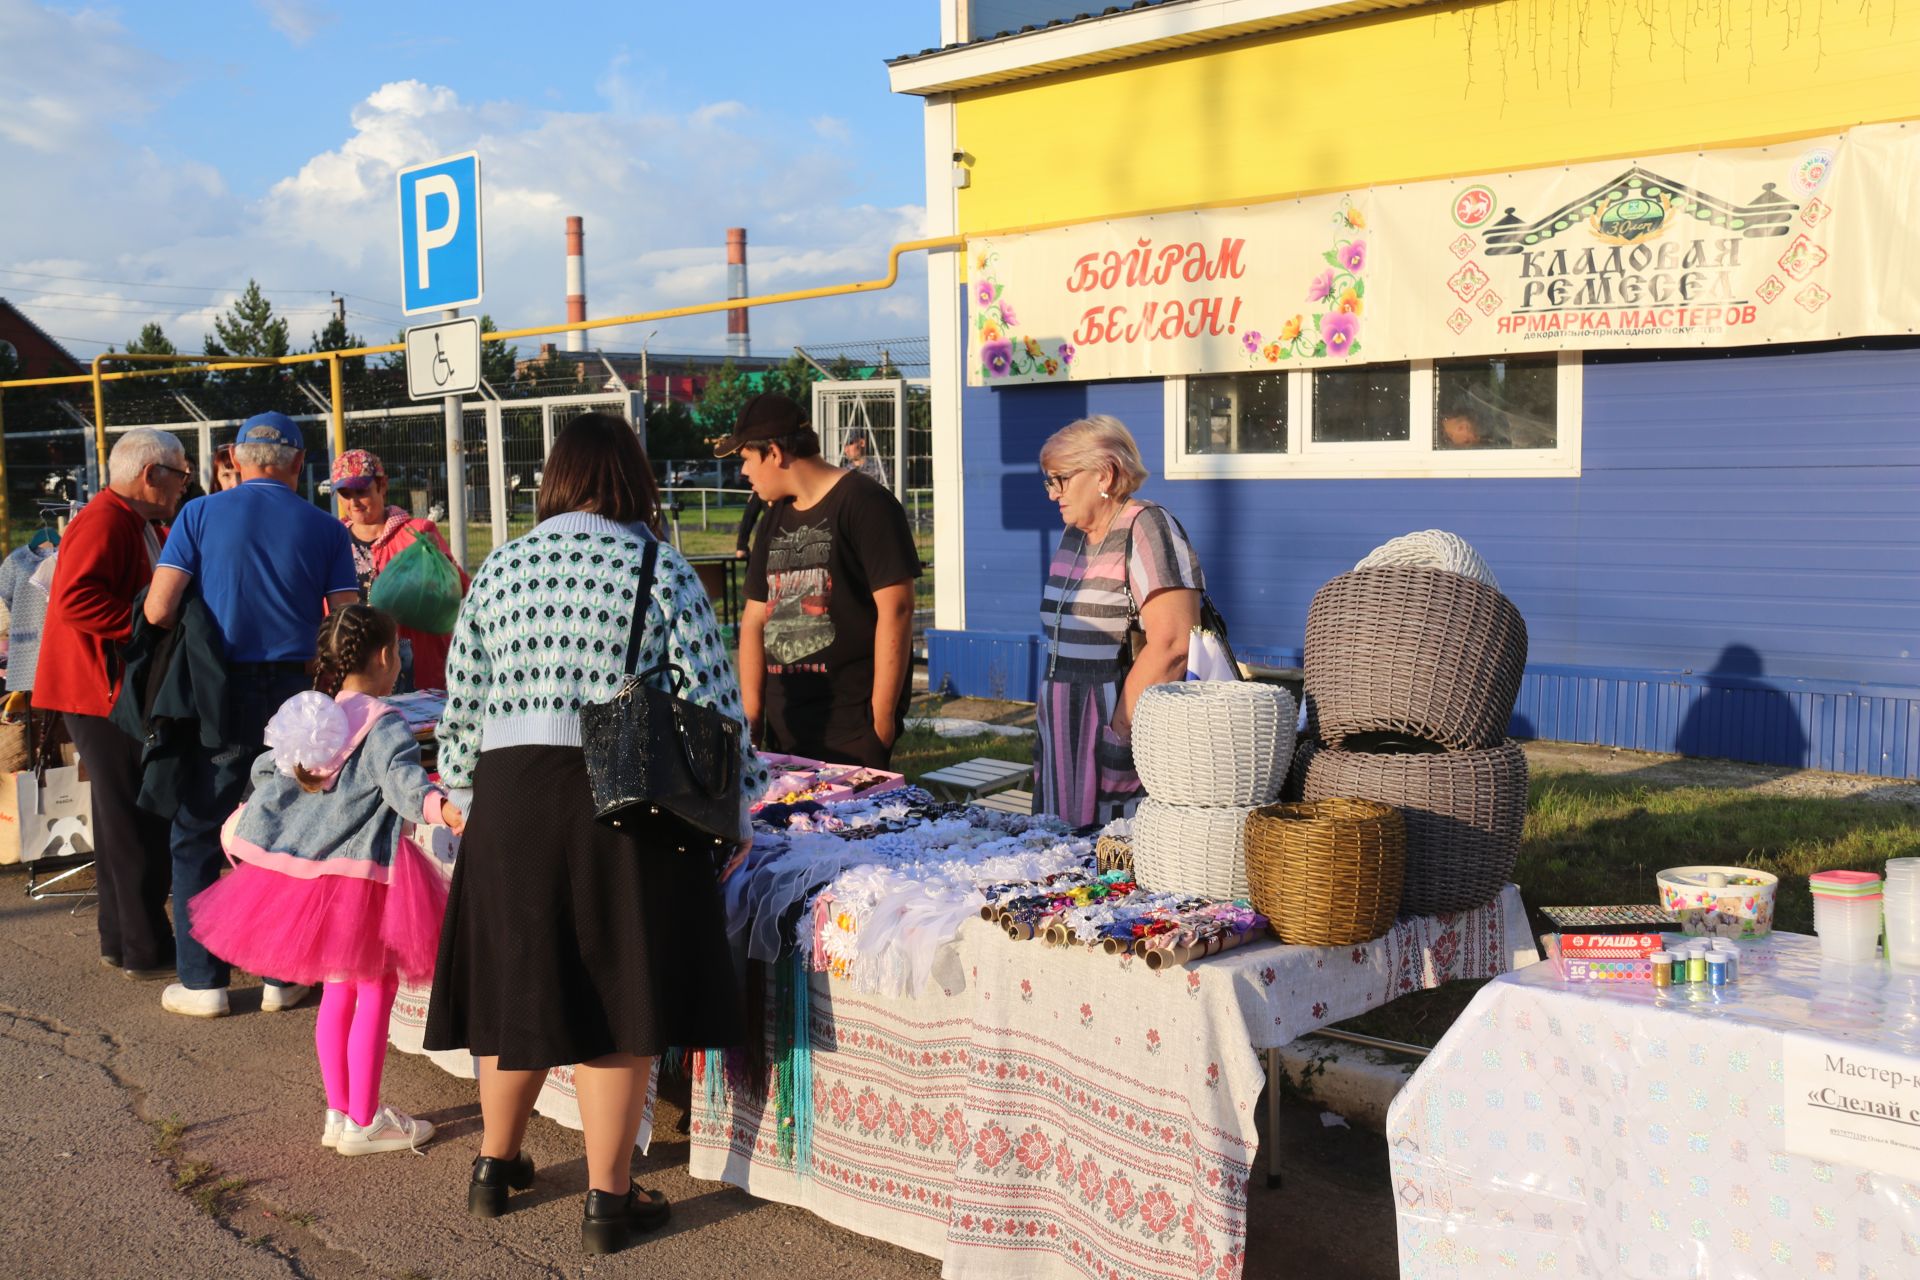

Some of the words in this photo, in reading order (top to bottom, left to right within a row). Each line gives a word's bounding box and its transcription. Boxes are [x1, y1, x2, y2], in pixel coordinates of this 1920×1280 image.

[415, 174, 461, 289] P
[1607, 220, 1631, 235] 30
[1519, 238, 1743, 278] КЛАДОВАЯ
[1520, 271, 1736, 308] РЕМЕСЕЛ
[1497, 312, 1612, 334] ЯРМАРКА
[1618, 305, 1757, 329] МАСТЕРОВ
[1588, 936, 1638, 947] ГУАШЬ
[1570, 966, 1586, 975] 16
[1807, 1086, 1902, 1119] «Сделай
